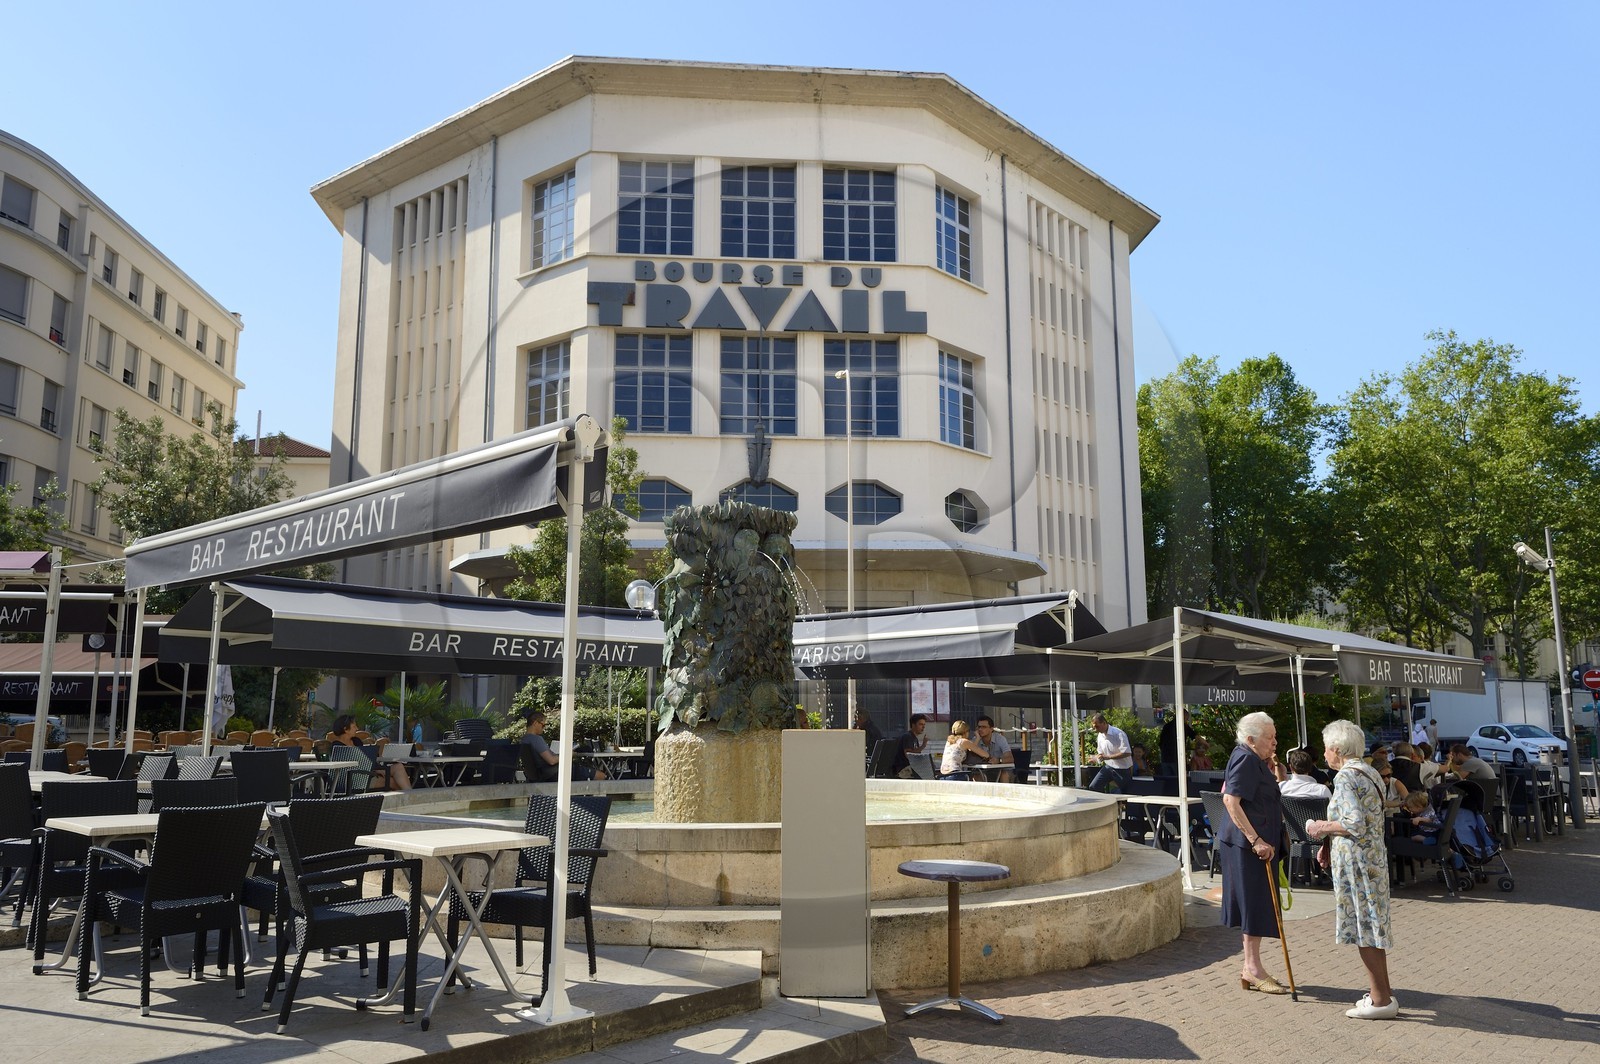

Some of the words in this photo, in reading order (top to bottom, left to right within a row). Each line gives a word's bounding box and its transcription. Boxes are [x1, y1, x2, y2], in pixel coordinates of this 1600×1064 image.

[634, 260, 804, 286] BOURSE
[830, 266, 882, 288] DU
[587, 281, 927, 334] TRAVAIL
[189, 538, 226, 572] BAR
[245, 492, 405, 561] RESTAURANT
[408, 632, 462, 653] BAR
[792, 644, 866, 664] 'ARISTO
[1369, 659, 1392, 681] BAR
[1403, 662, 1463, 685] RESTAURANT
[2, 681, 84, 696] RESTARANT
[1208, 687, 1246, 702] L'ARISTO
